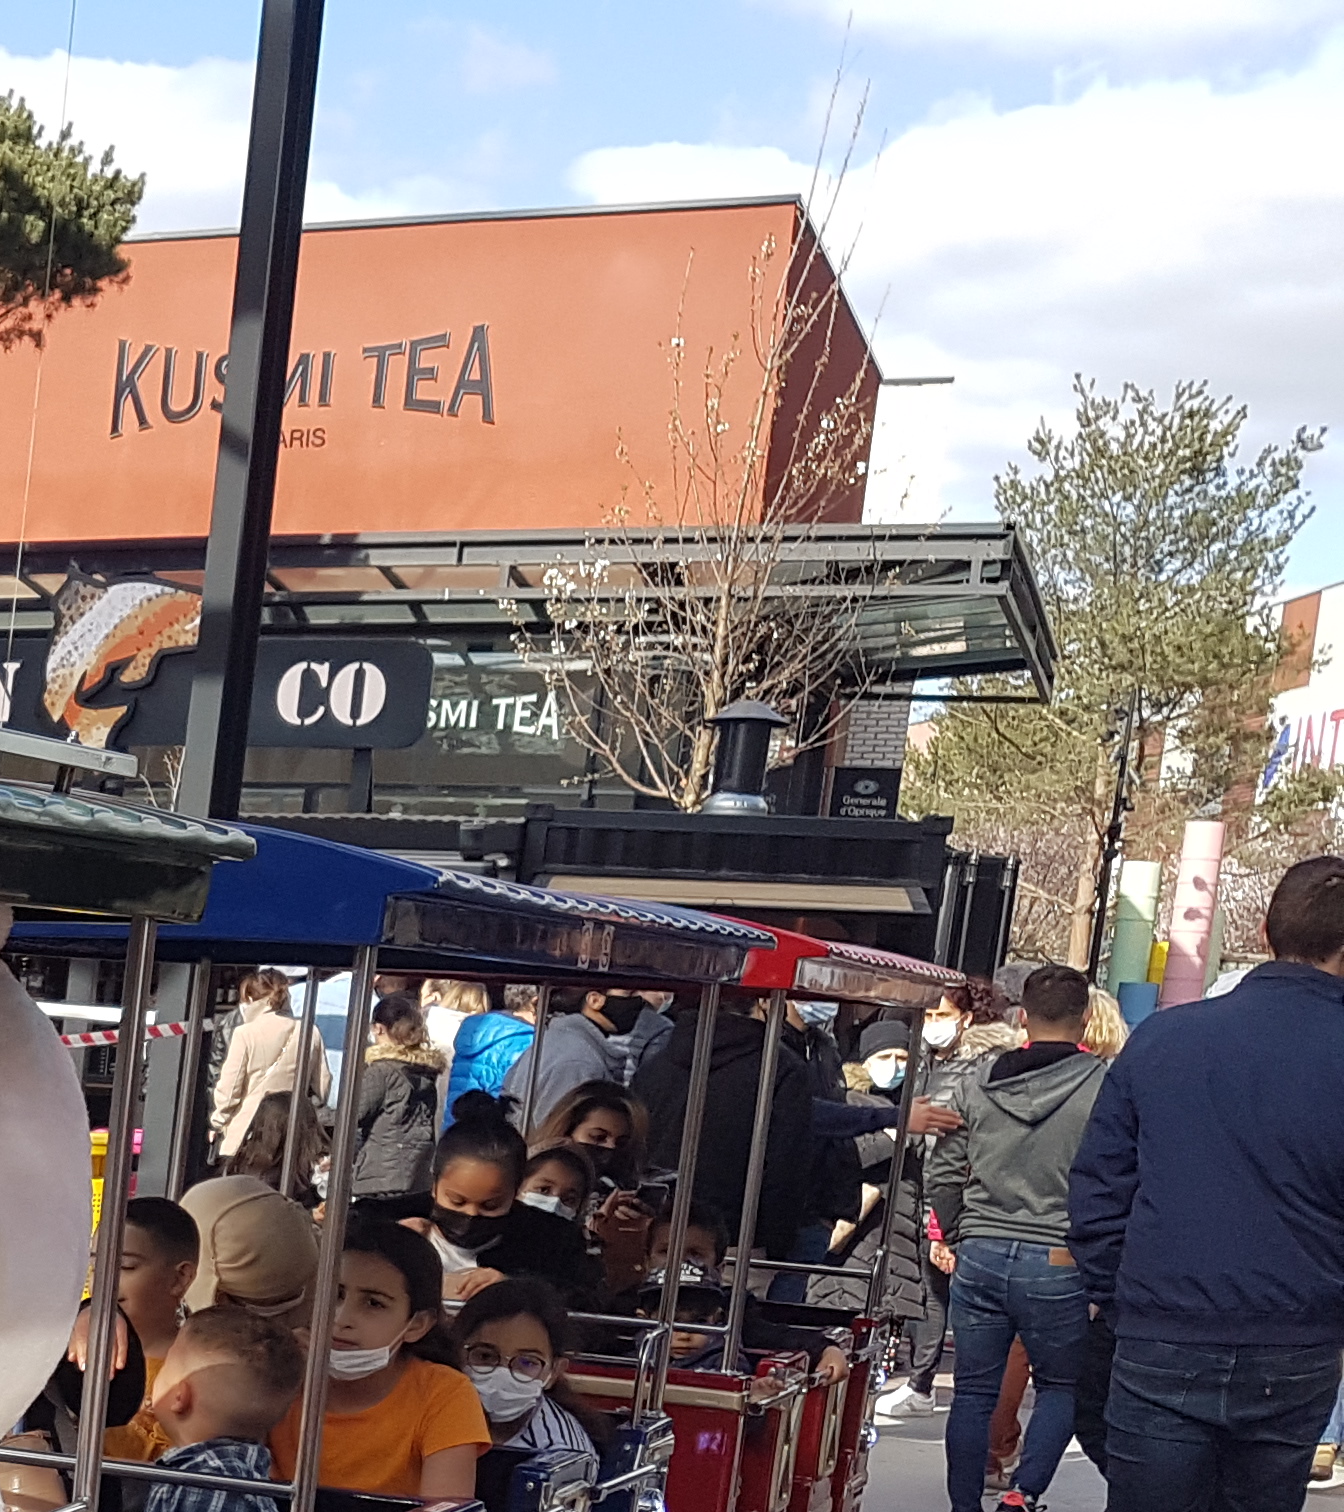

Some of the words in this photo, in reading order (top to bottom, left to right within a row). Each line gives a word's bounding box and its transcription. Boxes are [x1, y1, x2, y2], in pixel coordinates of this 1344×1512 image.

[362, 323, 495, 424] TEA
[280, 427, 326, 449] ARIS
[276, 660, 387, 727] CO
[492, 690, 560, 740] TEA
